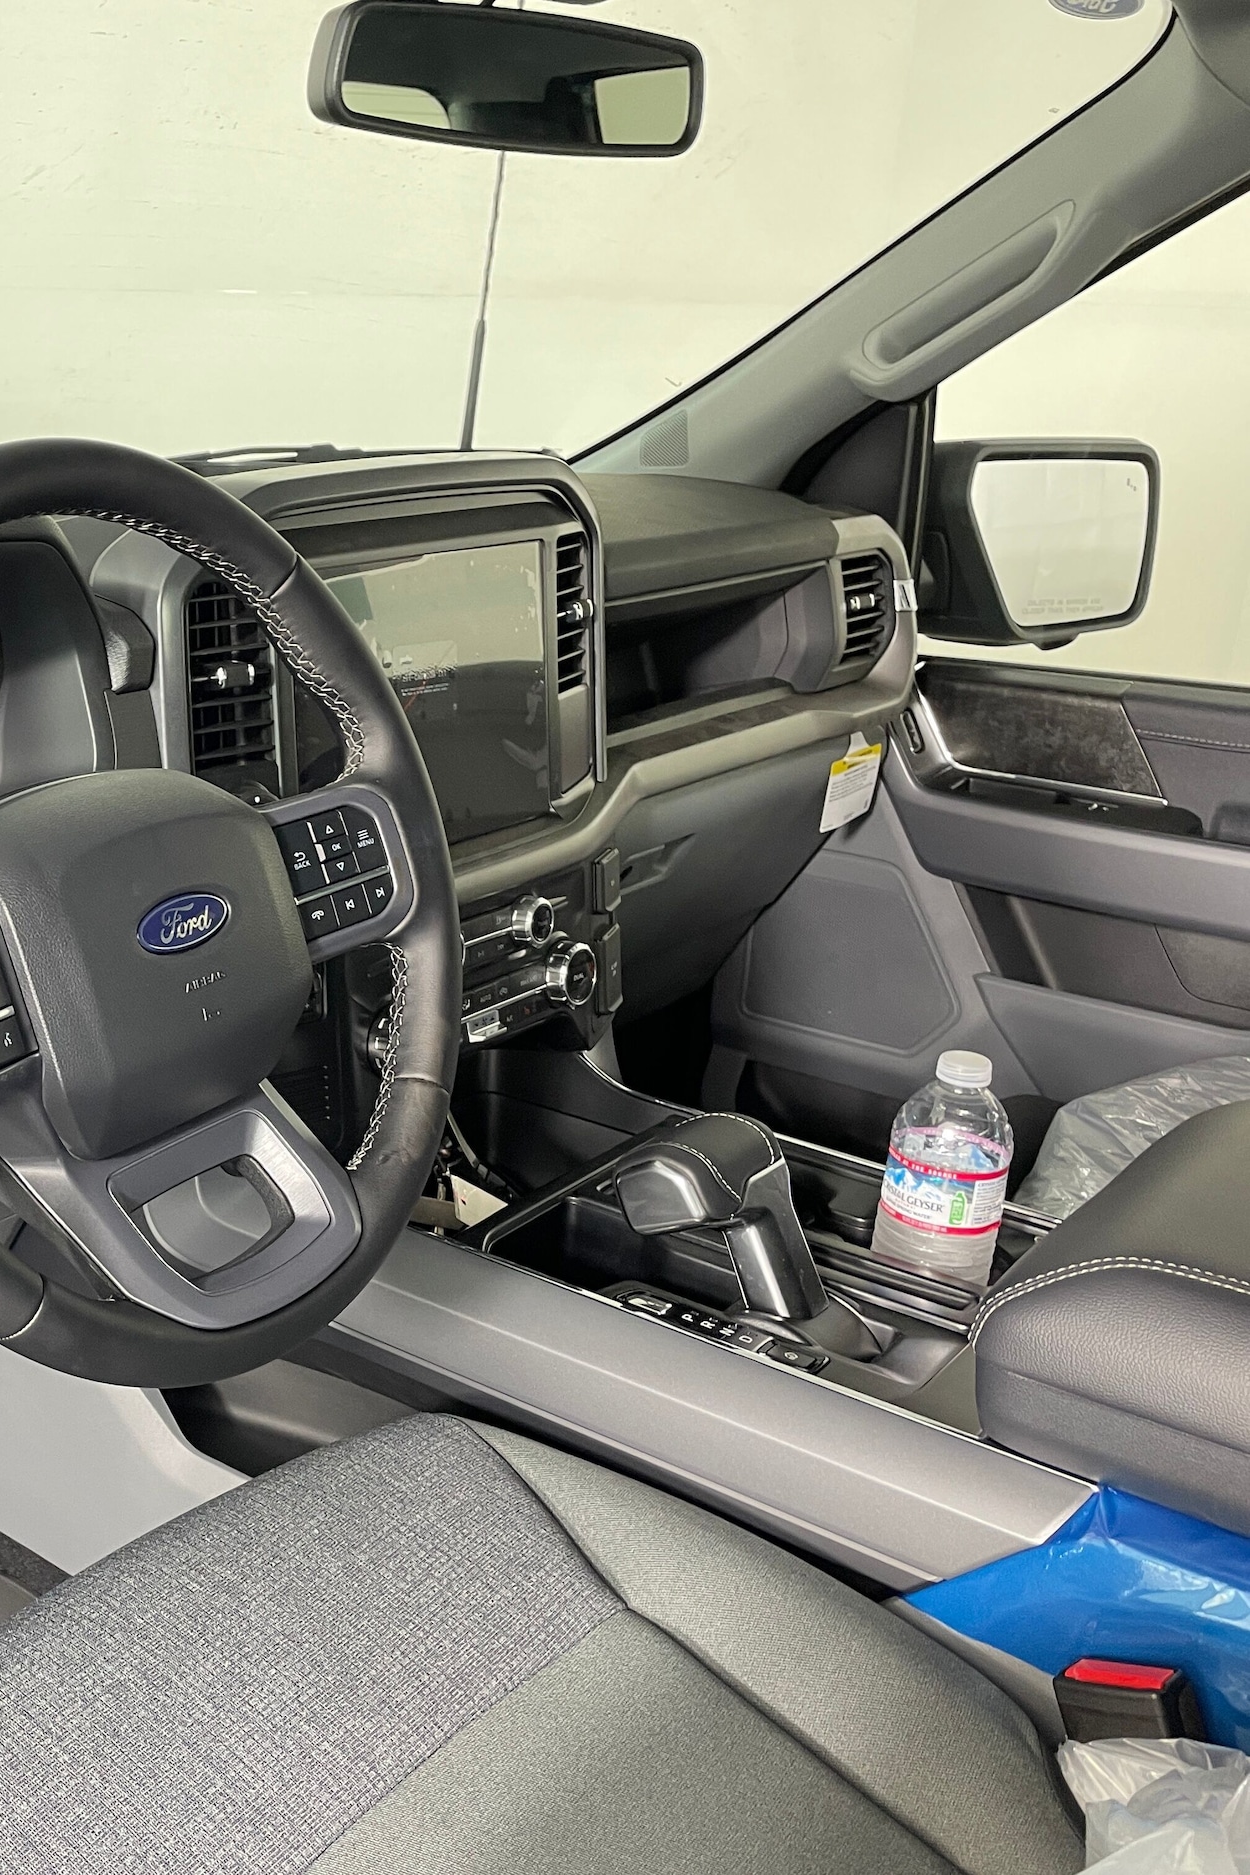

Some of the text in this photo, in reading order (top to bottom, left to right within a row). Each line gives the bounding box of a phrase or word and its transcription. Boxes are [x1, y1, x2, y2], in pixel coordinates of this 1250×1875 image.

[331, 843, 342, 851] OK
[357, 838, 375, 848] MENU
[293, 860, 311, 871] BACK
[160, 902, 212, 944] Ford
[906, 1195, 944, 1213] GEYSER
[681, 1313, 694, 1322] P
[700, 1320, 716, 1330] R
[738, 1335, 753, 1344] D
